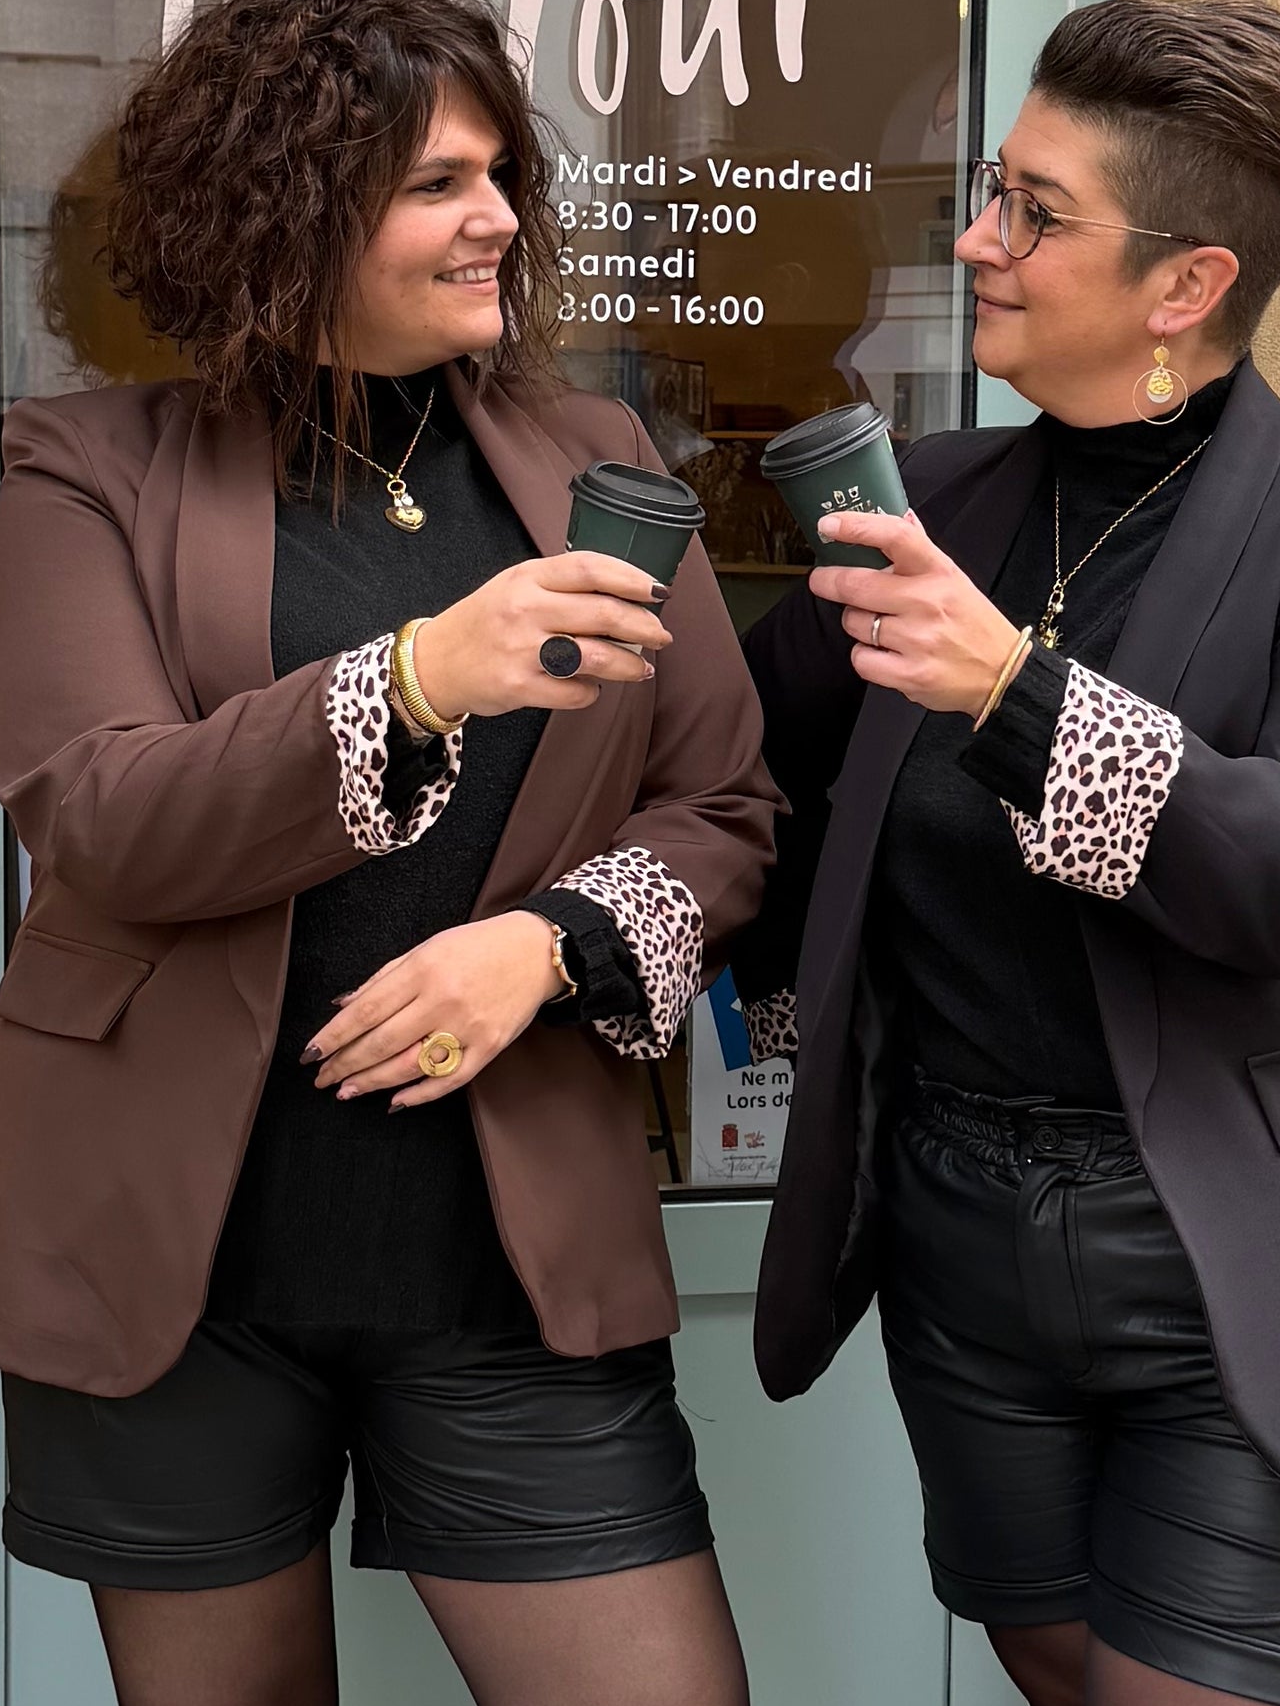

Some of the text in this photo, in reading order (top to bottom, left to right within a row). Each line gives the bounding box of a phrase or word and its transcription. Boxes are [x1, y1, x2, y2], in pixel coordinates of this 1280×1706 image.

[557, 154, 667, 187] Mardi
[706, 157, 873, 193] Vendredi
[557, 200, 634, 232] 8:30
[667, 202, 758, 235] 17:00
[556, 246, 696, 279] Samedi
[557, 291, 636, 324] 8:00
[670, 294, 765, 326] 16:00
[741, 1070, 766, 1086] Ne
[726, 1093, 767, 1109] Lors
